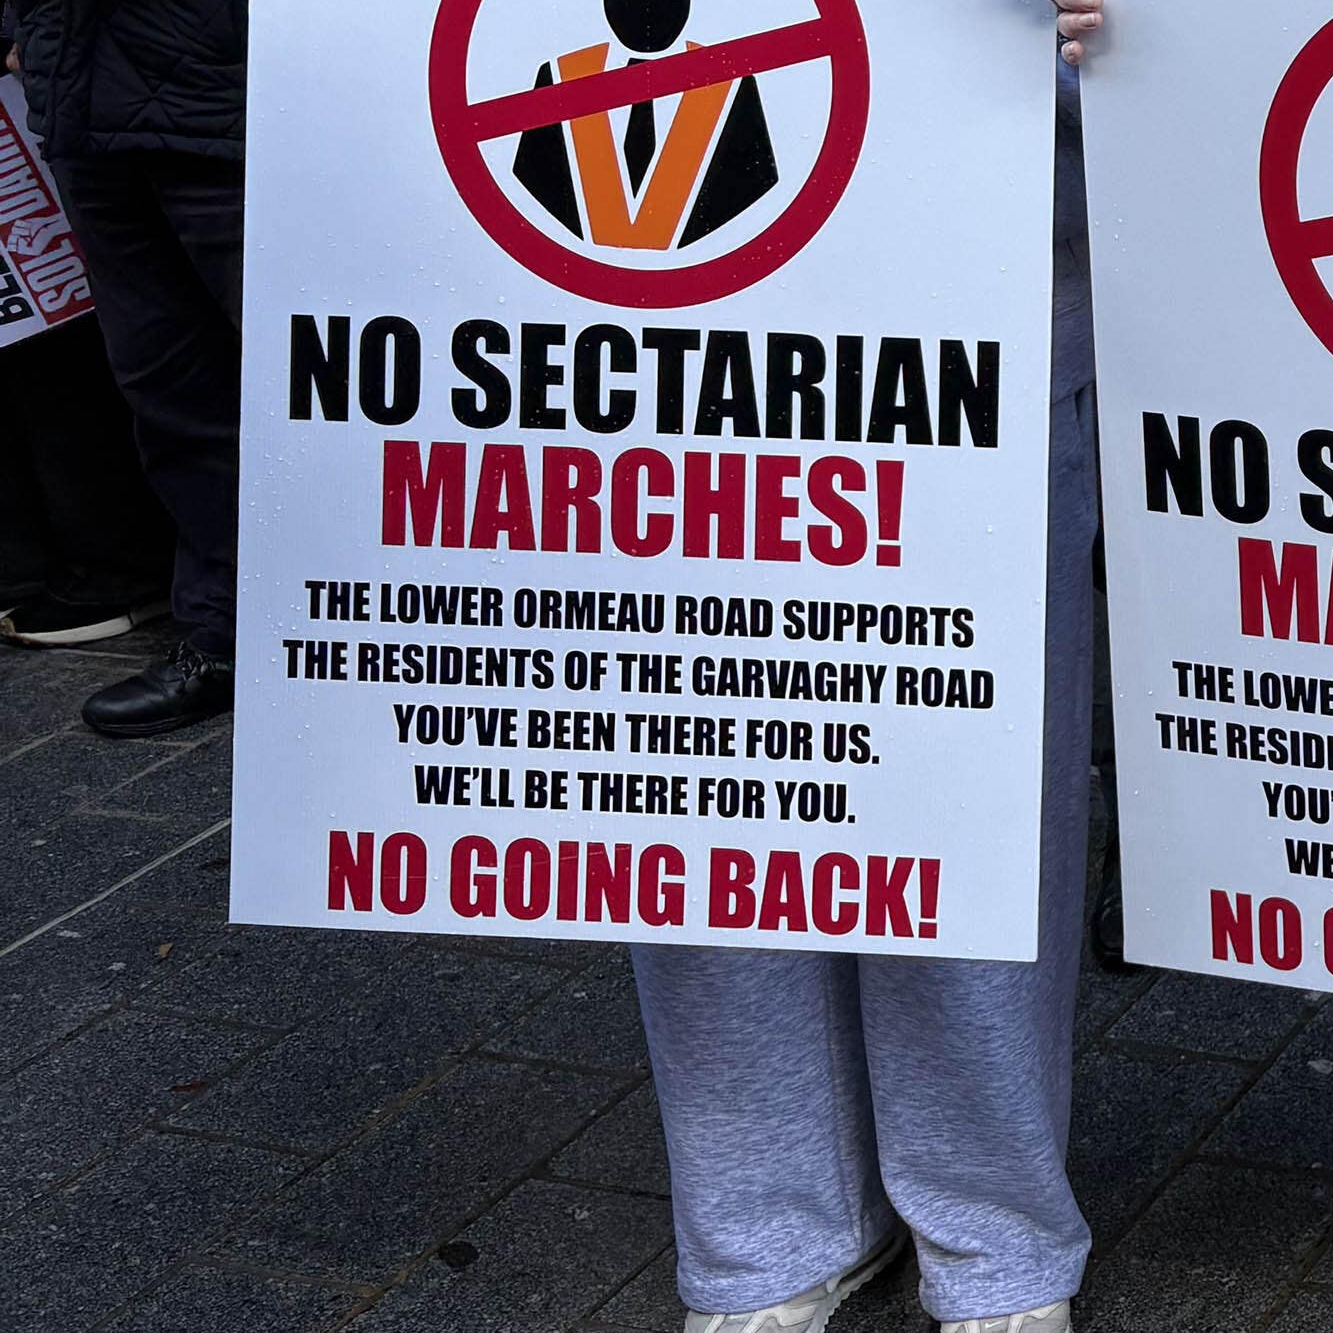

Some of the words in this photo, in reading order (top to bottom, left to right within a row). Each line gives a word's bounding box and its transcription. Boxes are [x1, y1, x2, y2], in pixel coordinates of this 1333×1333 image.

[289, 314, 421, 425] NO
[452, 319, 1000, 448] SECTARIAN
[1143, 411, 1270, 524] NO
[382, 440, 904, 567] MARCHES!
[305, 580, 370, 621] THE
[380, 584, 503, 626] LOWER
[514, 589, 664, 633] ORMEAU
[676, 595, 773, 637] ROAD
[784, 600, 973, 648] SUPPORTS
[283, 640, 347, 680] THE
[358, 643, 554, 689] RESIDENTS
[565, 651, 608, 690] OF
[616, 653, 682, 694] THE
[693, 656, 887, 703] GARVAGHY
[896, 666, 993, 709] ROAD
[1172, 661, 1235, 703] THE
[528, 710, 615, 751] BEEN
[625, 714, 735, 757] THERE
[746, 719, 812, 760] FOR
[824, 723, 879, 764] US.
[1155, 713, 1218, 755] THE
[525, 770, 568, 810] BE
[578, 772, 688, 815] THERE
[699, 778, 764, 819] FOR
[775, 781, 855, 823] YOU.
[328, 831, 427, 914] NO
[450, 835, 685, 926] GOING
[708, 848, 940, 939] BACK!
[1211, 890, 1302, 971] NO
